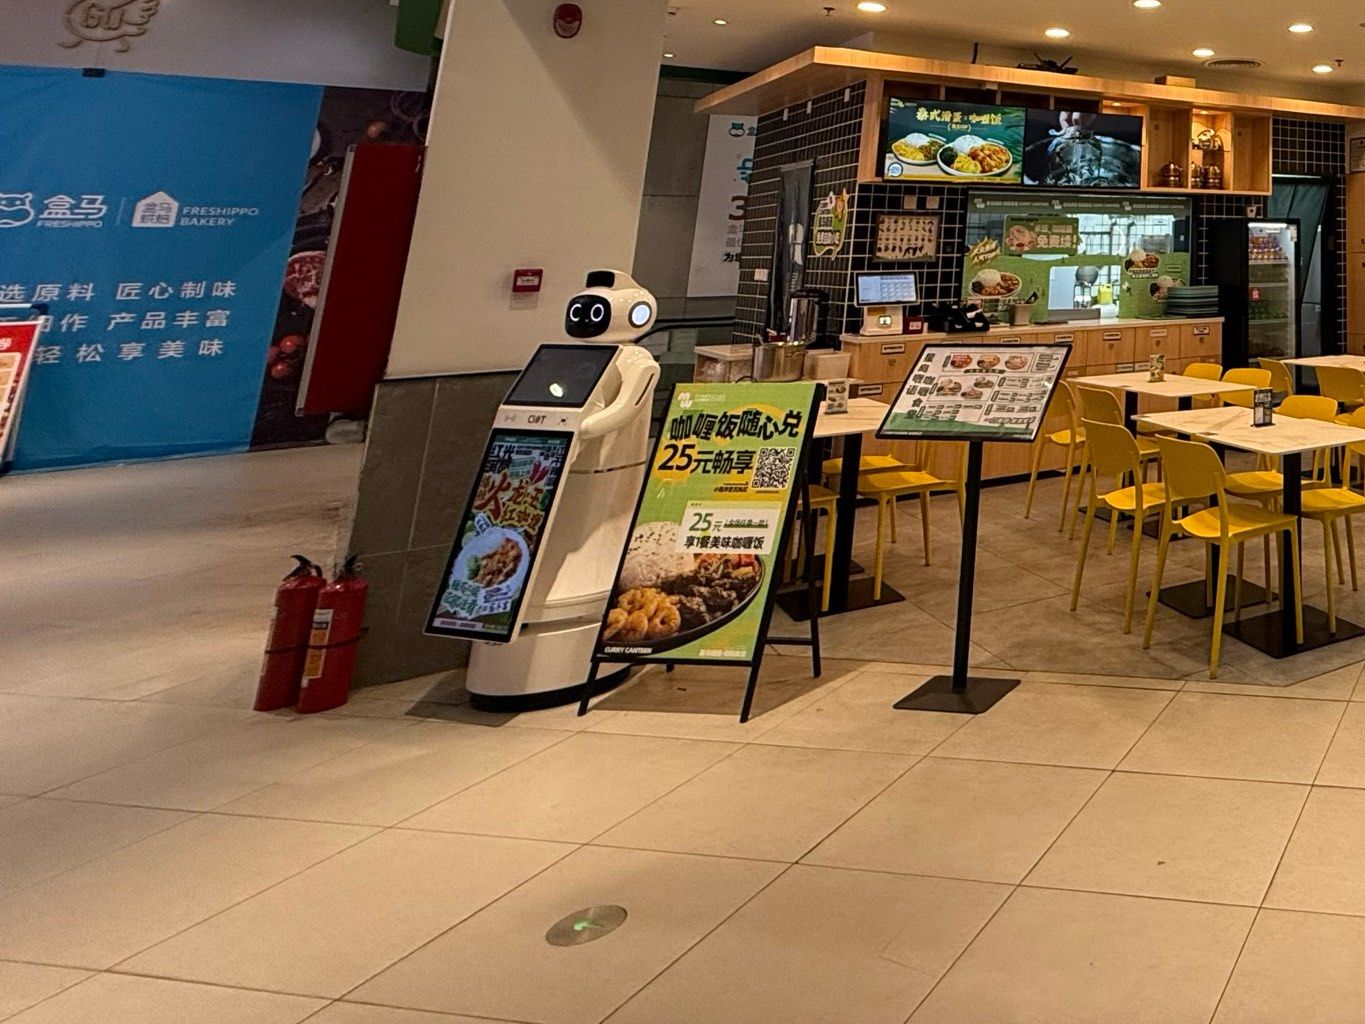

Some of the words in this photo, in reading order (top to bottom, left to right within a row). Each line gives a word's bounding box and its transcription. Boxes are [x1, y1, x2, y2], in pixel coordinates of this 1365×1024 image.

[39, 194, 108, 219] 盒马
[182, 207, 260, 216] FRESHIPPO
[180, 217, 235, 226] BAKERY
[116, 281, 237, 300] 匠心制味
[106, 309, 231, 331] 产品丰富
[669, 408, 803, 442] 咖喱饭随心兑
[657, 443, 755, 475] 25元畅享
[688, 512, 723, 532] 25元
[604, 646, 624, 655] CURRY
[625, 647, 653, 655] CANTEEN
